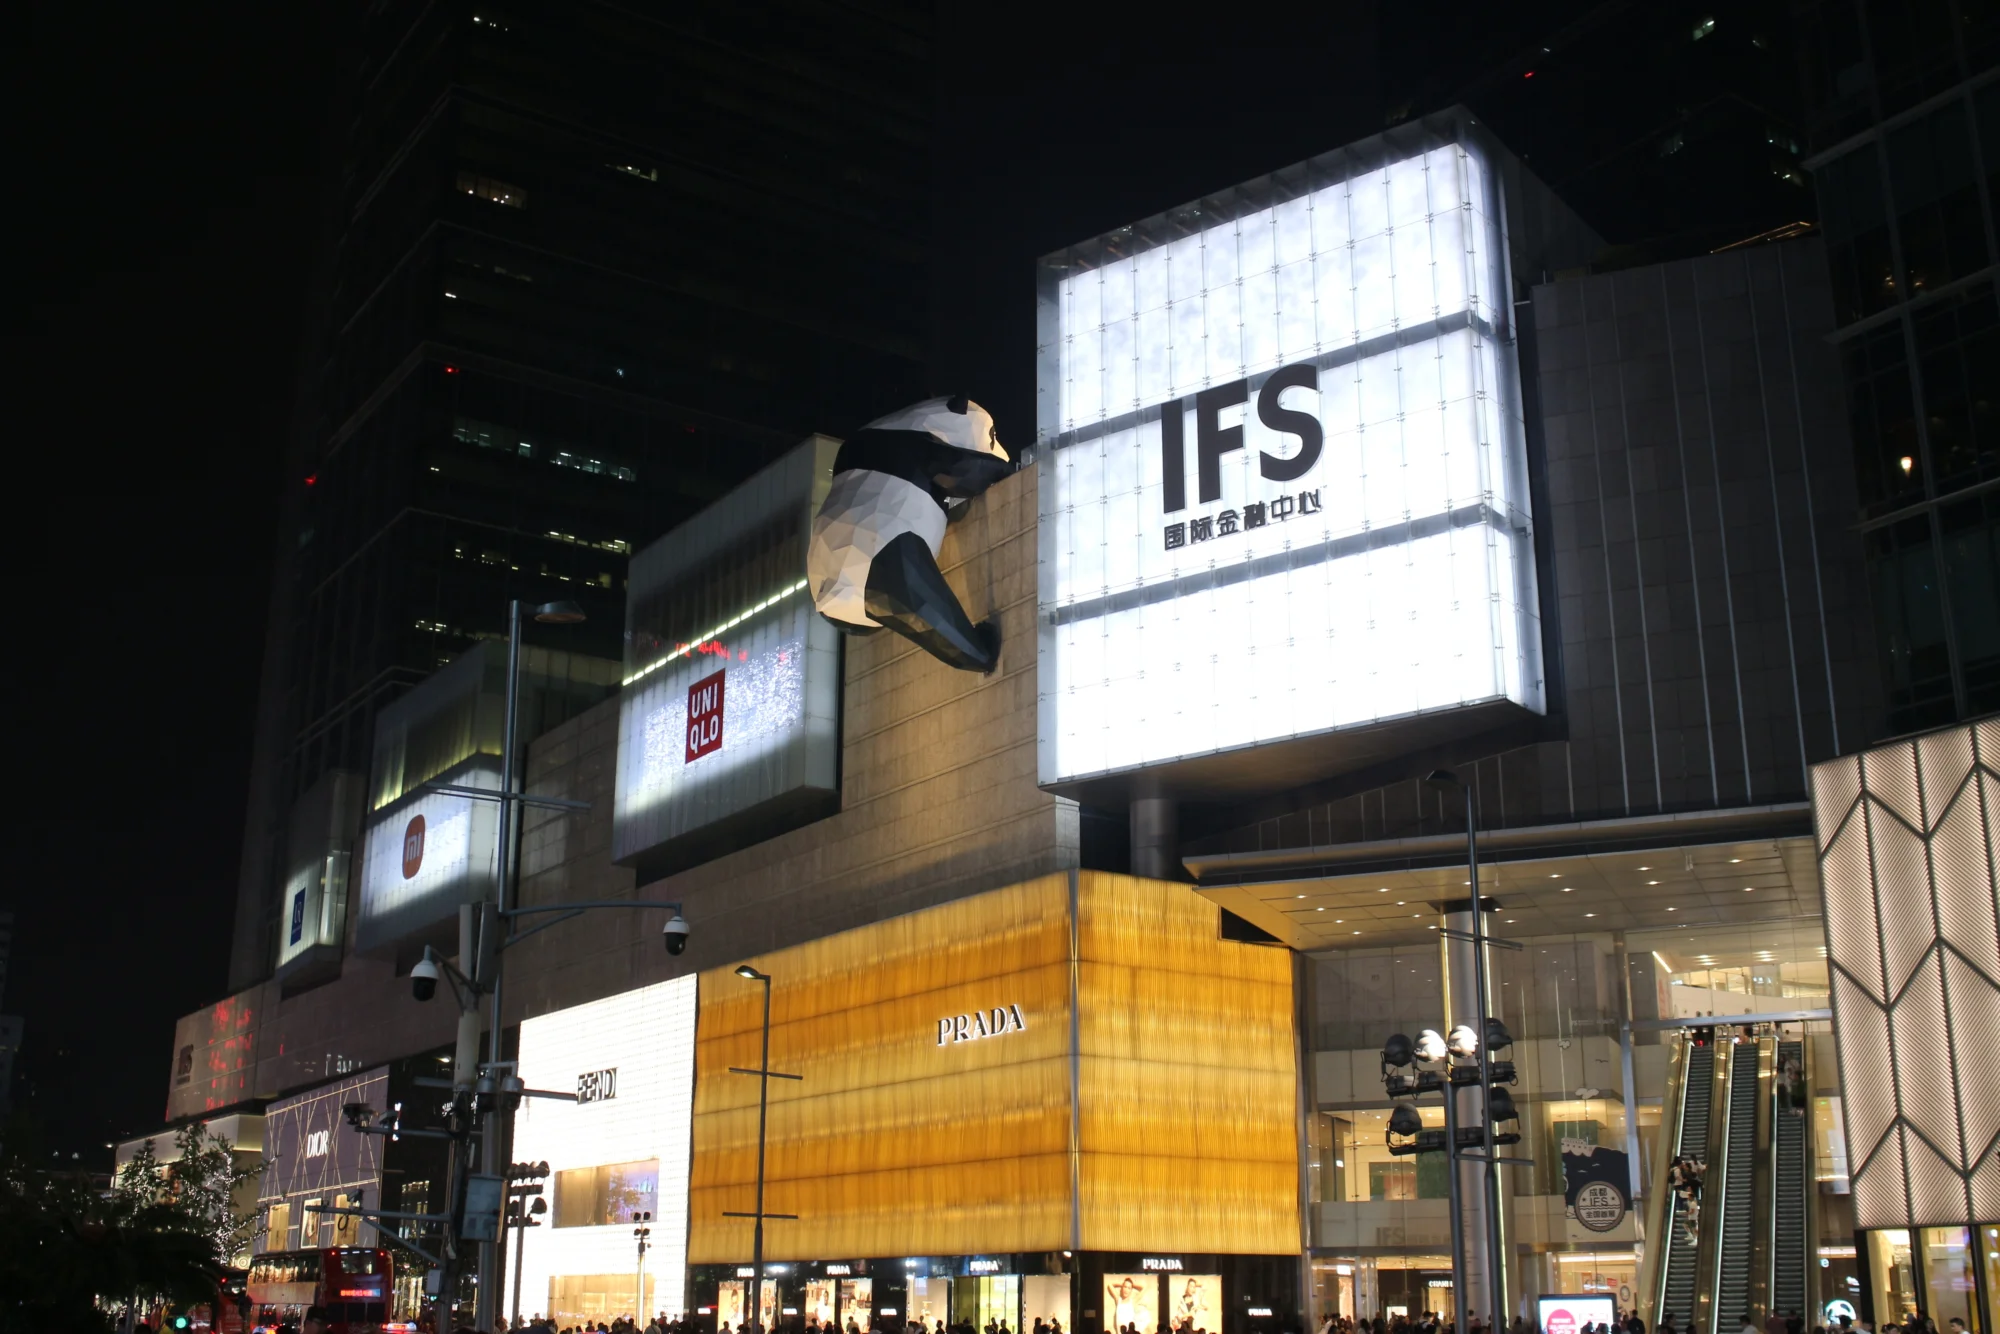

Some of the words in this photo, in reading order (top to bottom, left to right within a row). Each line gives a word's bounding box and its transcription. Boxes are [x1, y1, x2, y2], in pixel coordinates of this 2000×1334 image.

[1161, 364, 1324, 514] IFS
[1164, 488, 1322, 551] 国际金融中心
[691, 682, 718, 719] UNI
[690, 715, 719, 754] QLO
[937, 1004, 1026, 1046] PRADA
[306, 1129, 329, 1159] DIOR
[1590, 1197, 1609, 1206] IFS
[970, 1260, 999, 1271] PRADA
[1142, 1258, 1183, 1270] PRADA
